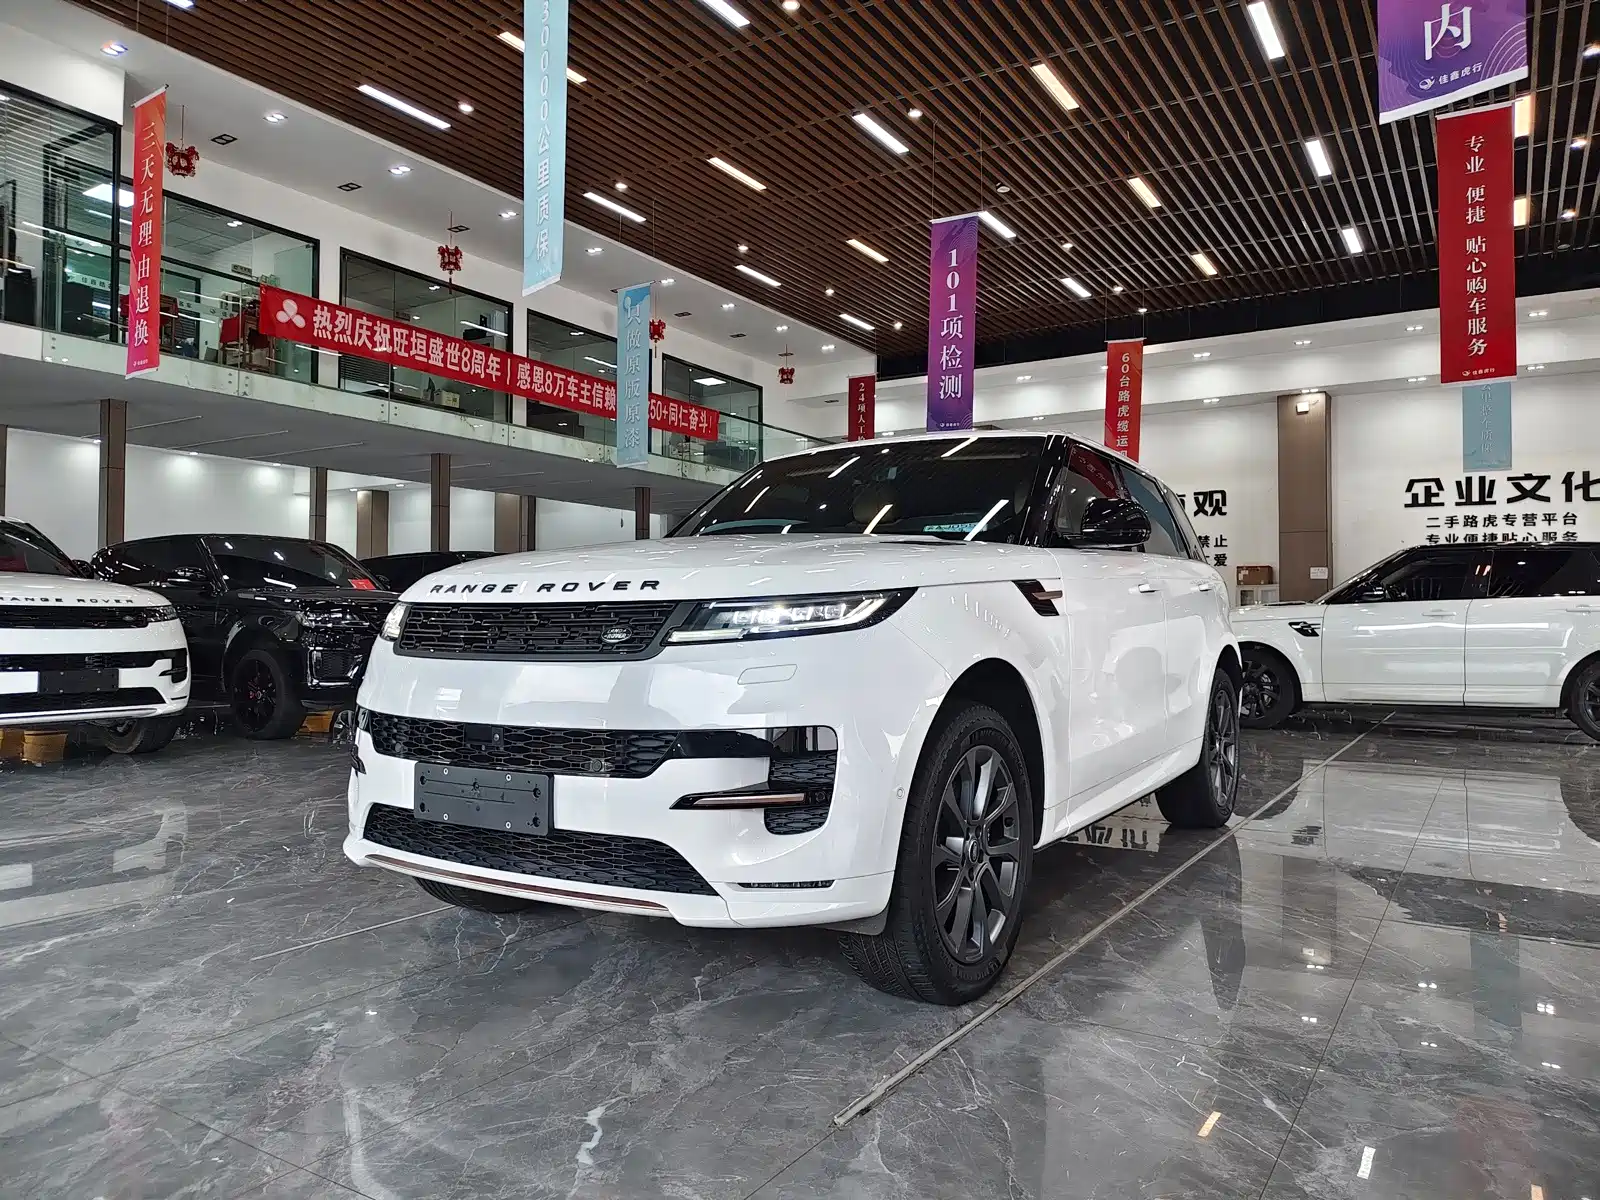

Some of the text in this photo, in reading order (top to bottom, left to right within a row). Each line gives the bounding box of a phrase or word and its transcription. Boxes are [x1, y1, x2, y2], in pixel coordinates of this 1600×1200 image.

[1423, 2, 1473, 61] 内
[1438, 62, 1484, 85] 佳鑫虎行
[133, 122, 155, 347] 三天无理由退换
[1464, 135, 1488, 357] 专业 便捷 贴心购车服务
[939, 249, 963, 399] 101项检测
[624, 305, 641, 449] 只做原版原漆
[648, 398, 713, 433] 50+同仁奋斗!
[1404, 471, 1600, 508] 企业文化
[1426, 512, 1578, 529] 二手路虎专营平台
[430, 580, 661, 594] RANGE ROVER
